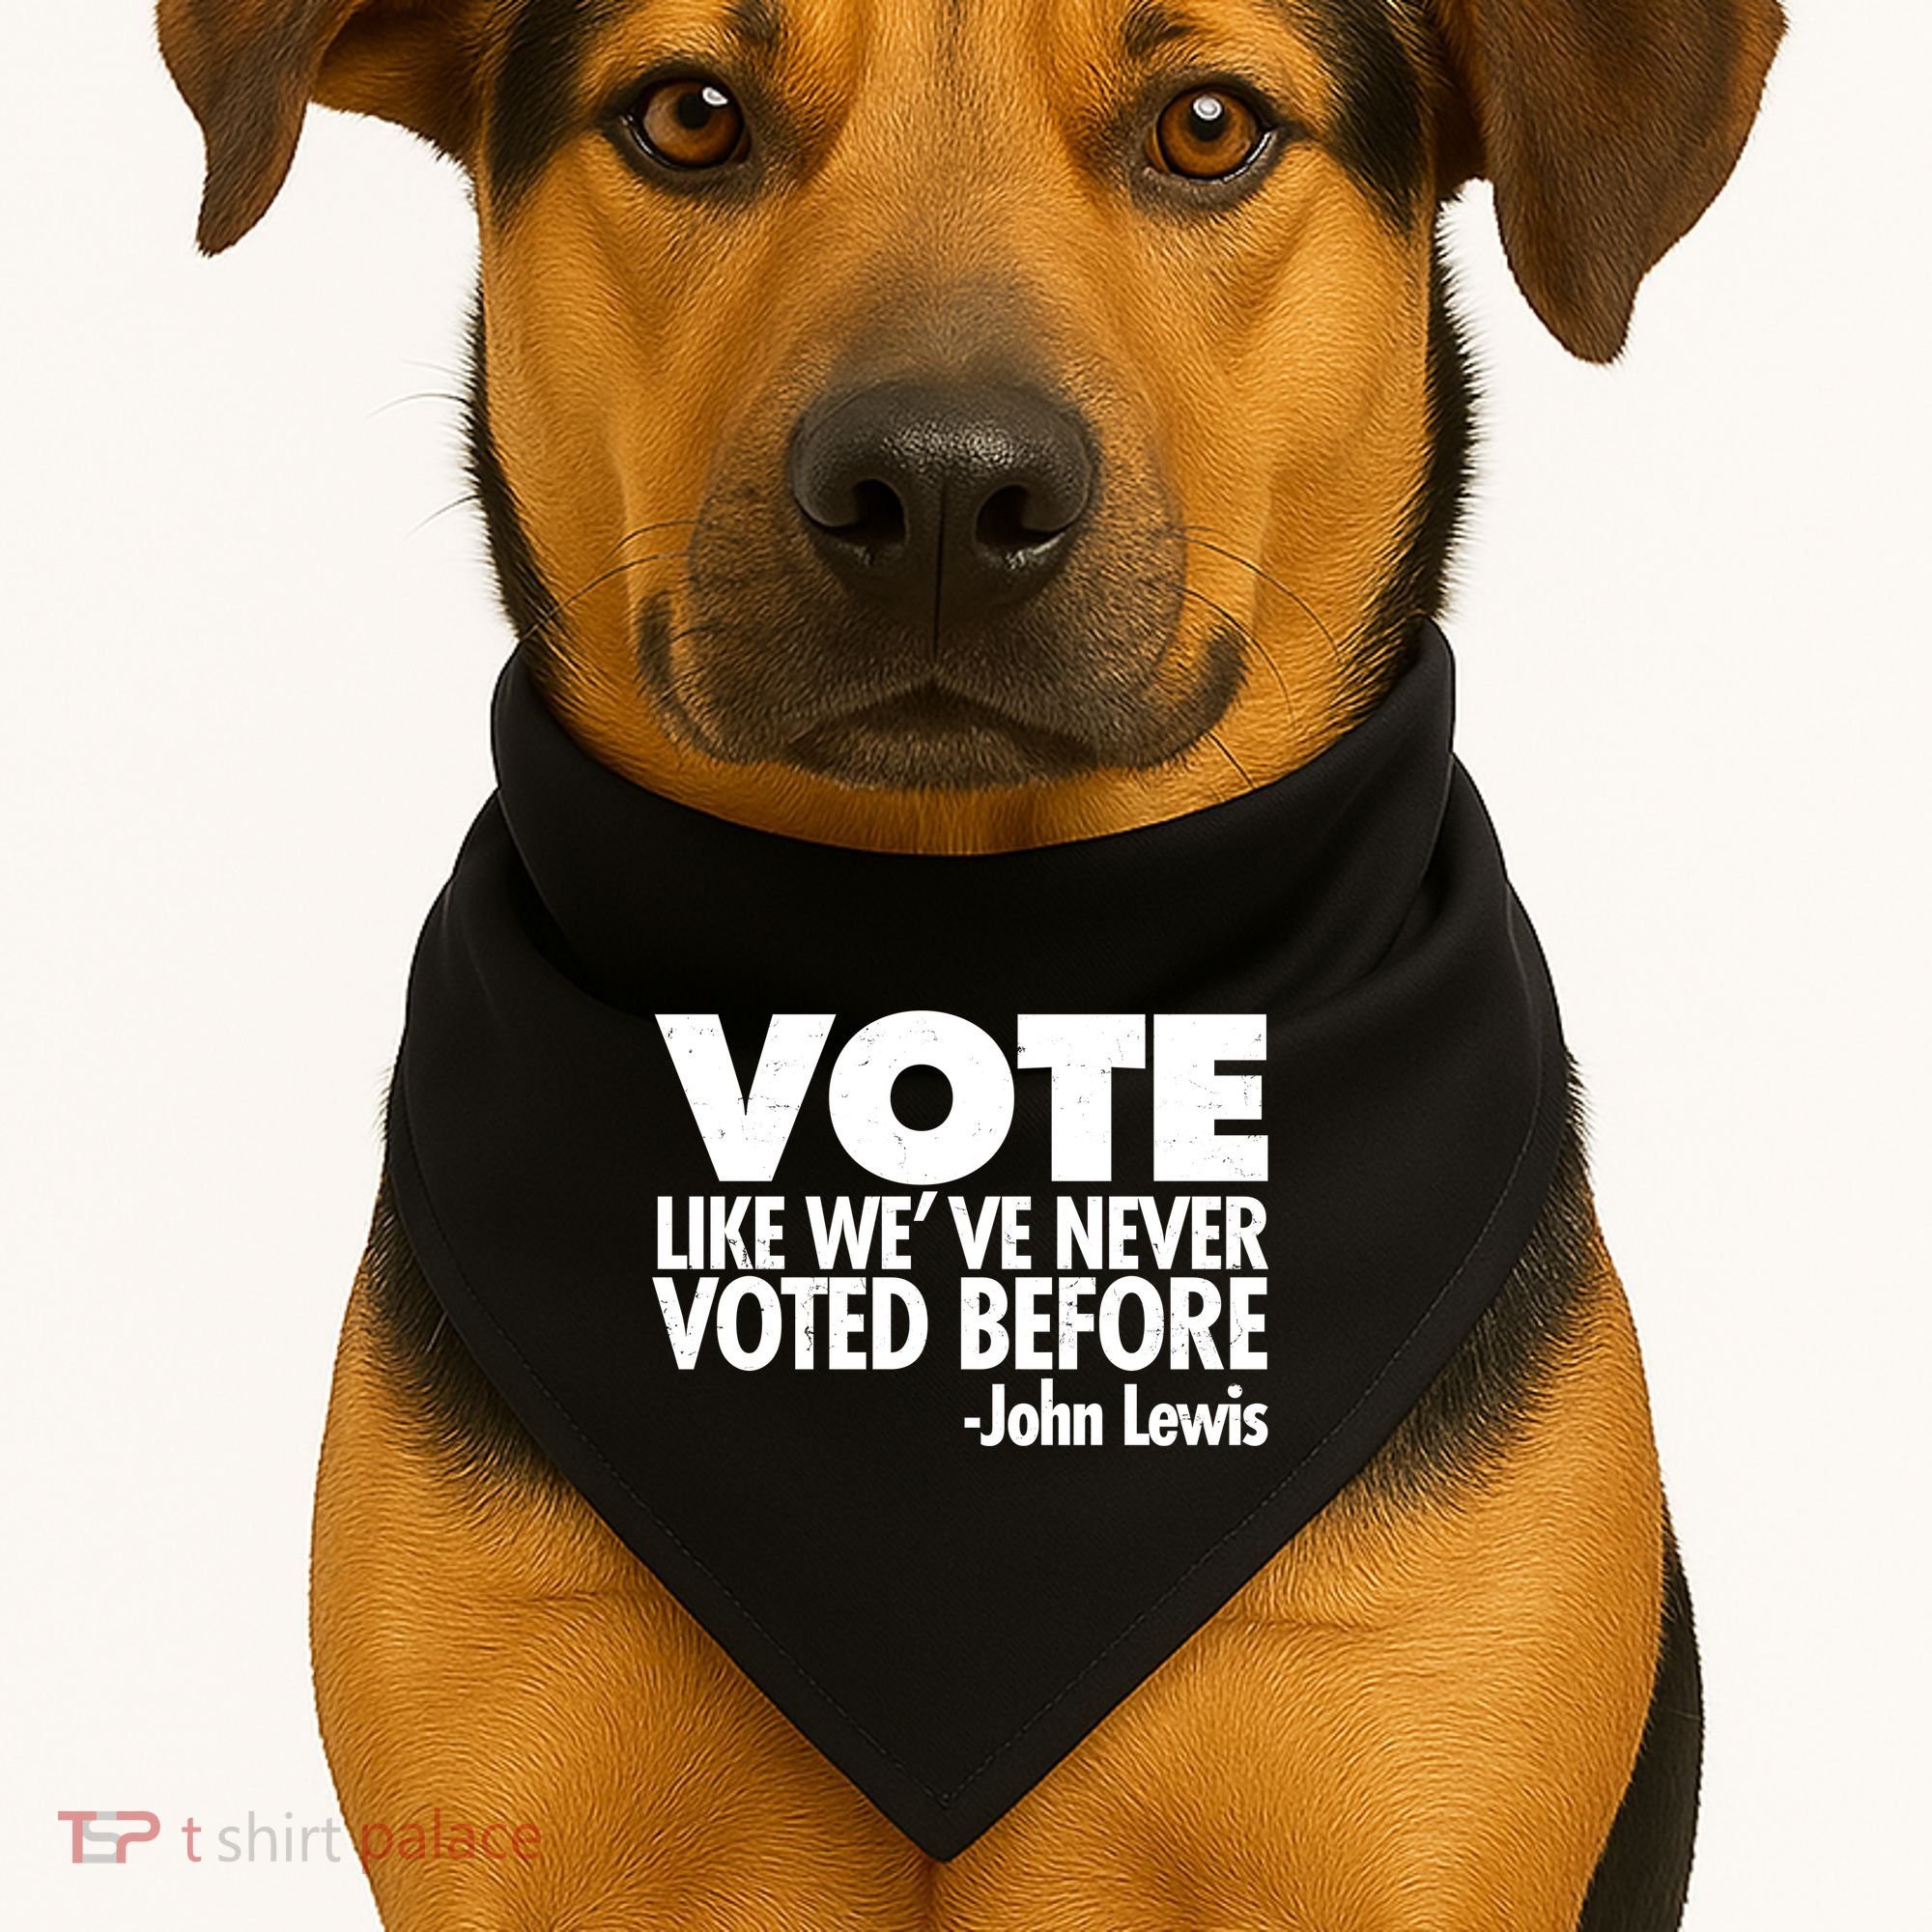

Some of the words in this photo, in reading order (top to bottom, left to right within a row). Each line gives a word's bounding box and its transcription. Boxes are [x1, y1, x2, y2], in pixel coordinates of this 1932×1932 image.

[655, 1010, 1268, 1185] VOTE
[658, 1196, 784, 1269] LIKE
[1057, 1196, 1268, 1269] NEVER
[652, 1276, 927, 1371] VOTED
[961, 1276, 1267, 1371] BEFORE
[964, 1378, 1102, 1446] -John
[1124, 1383, 1267, 1446] Lewis
